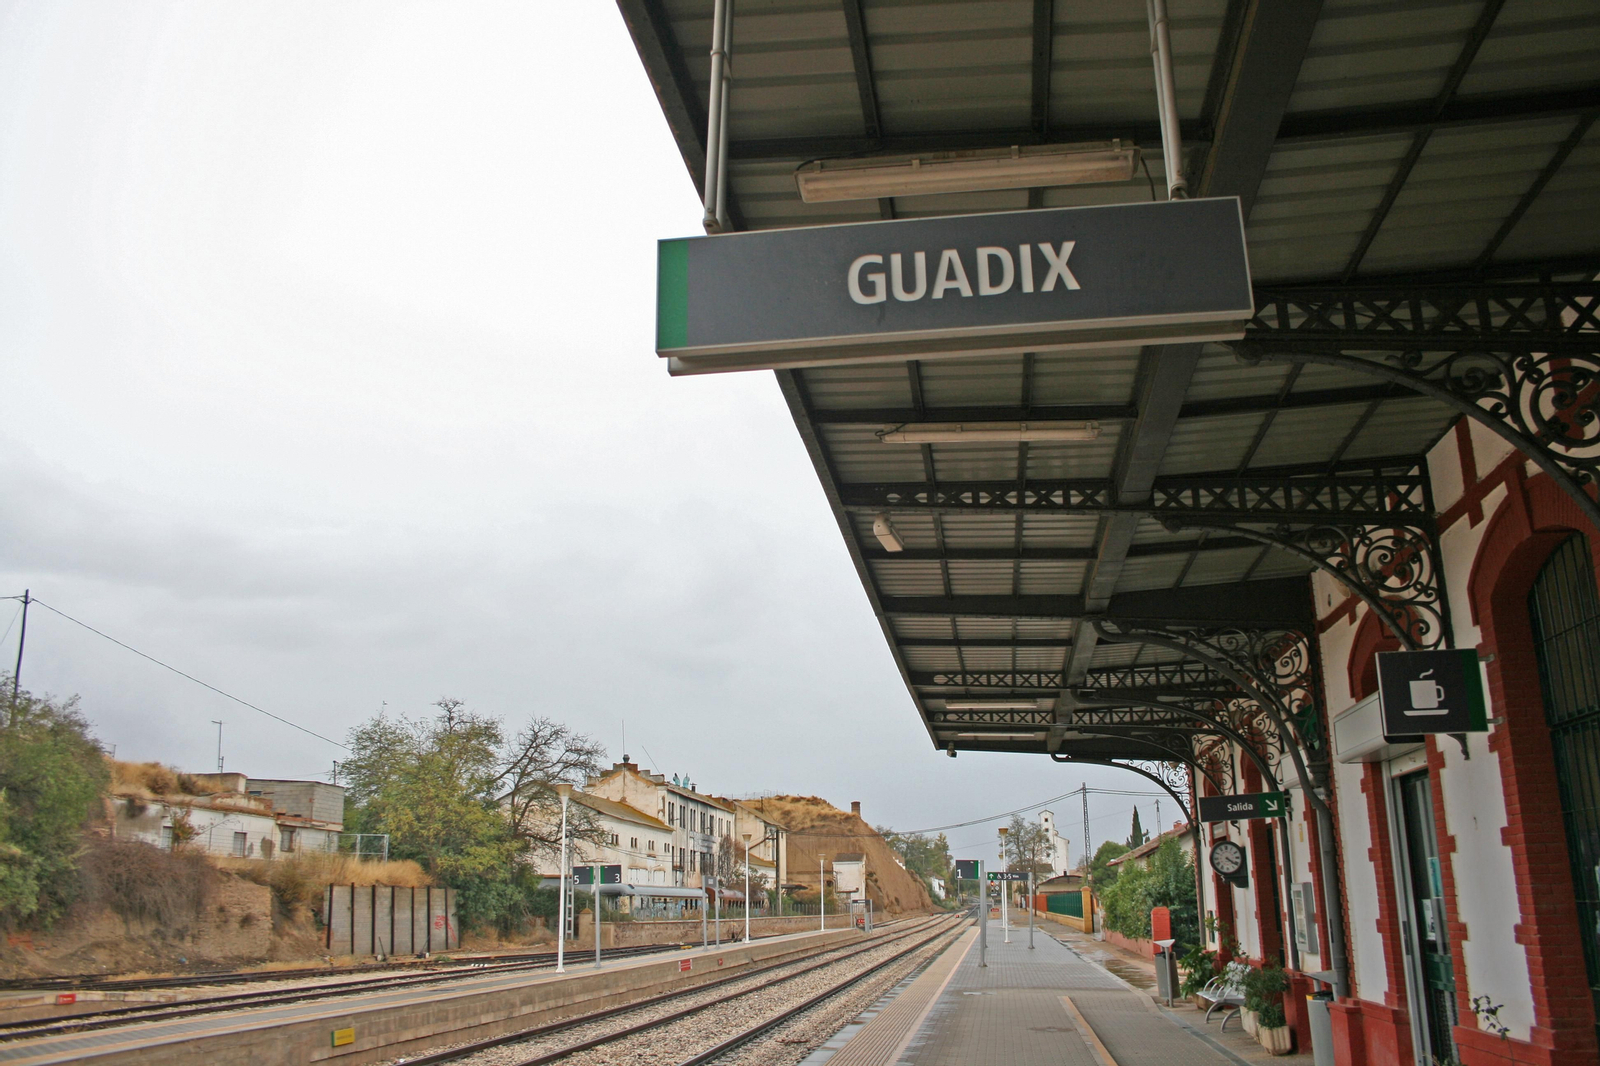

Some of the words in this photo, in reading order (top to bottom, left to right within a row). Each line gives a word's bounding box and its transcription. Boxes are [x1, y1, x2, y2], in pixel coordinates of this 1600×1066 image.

[848, 240, 1081, 305] GUADIX
[1227, 802, 1253, 812] Salida
[614, 874, 620, 882] 3
[956, 868, 962, 878] 1
[574, 875, 580, 884] 5
